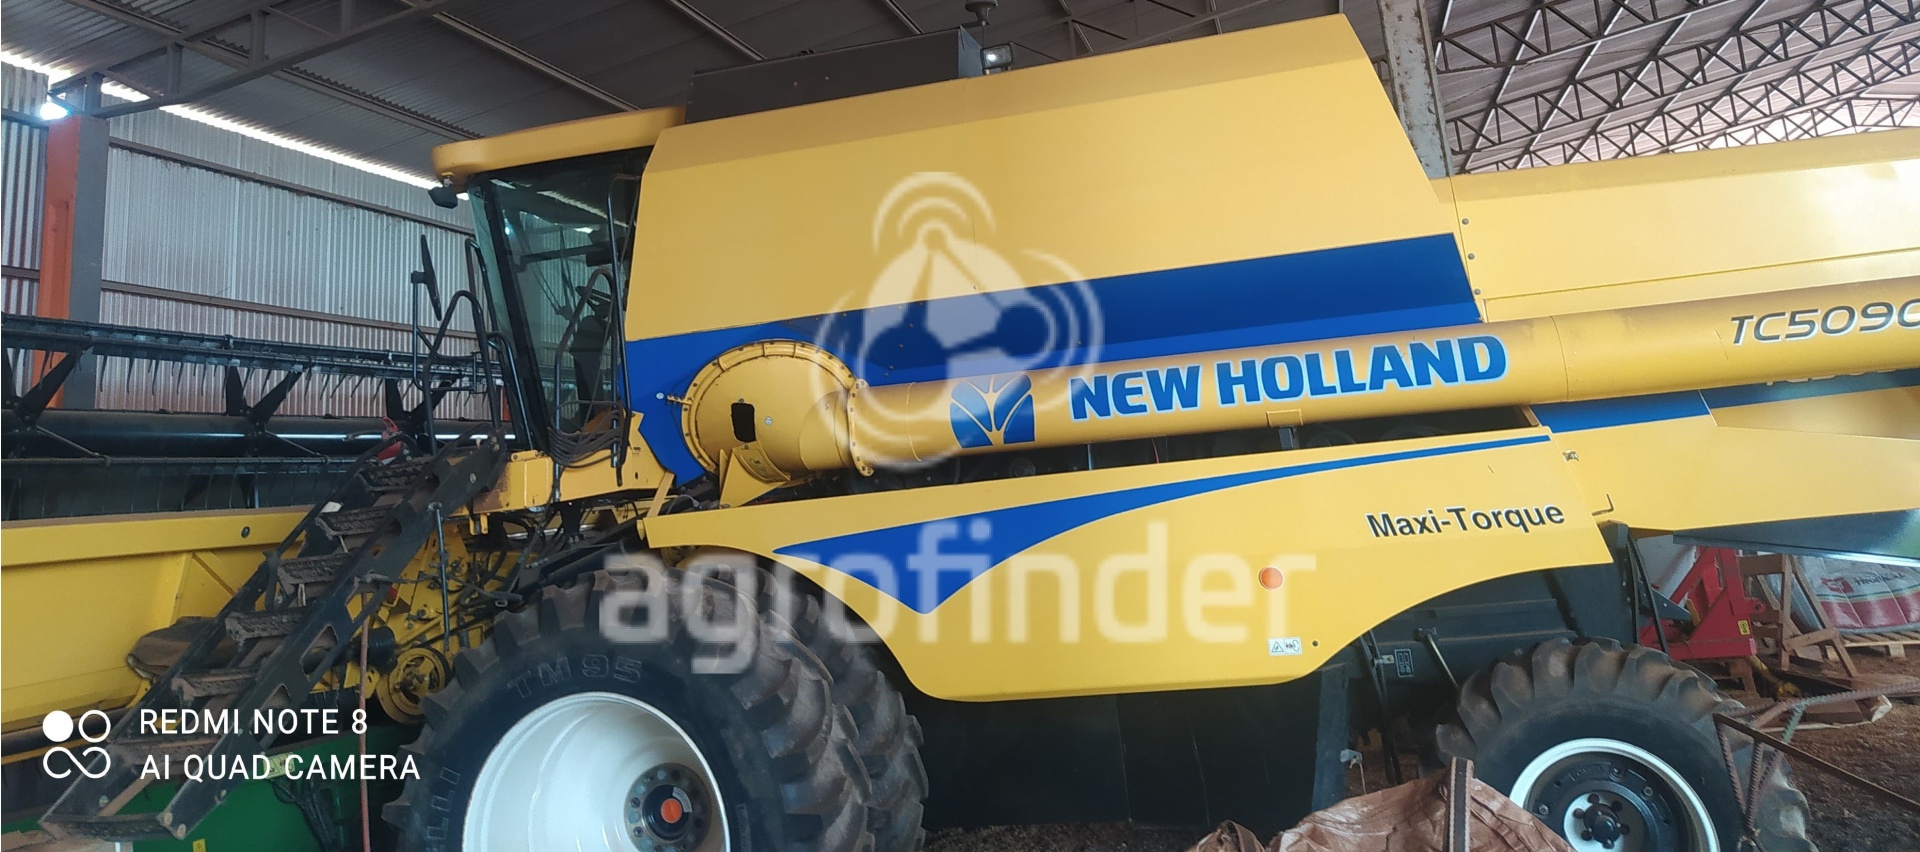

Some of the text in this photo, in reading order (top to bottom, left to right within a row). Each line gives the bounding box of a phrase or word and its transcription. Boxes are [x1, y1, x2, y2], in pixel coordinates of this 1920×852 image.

[1070, 335, 1508, 421] NEW HOLLAND
[1365, 503, 1566, 539] Maxi-Torque
[507, 653, 642, 699] TM 95
